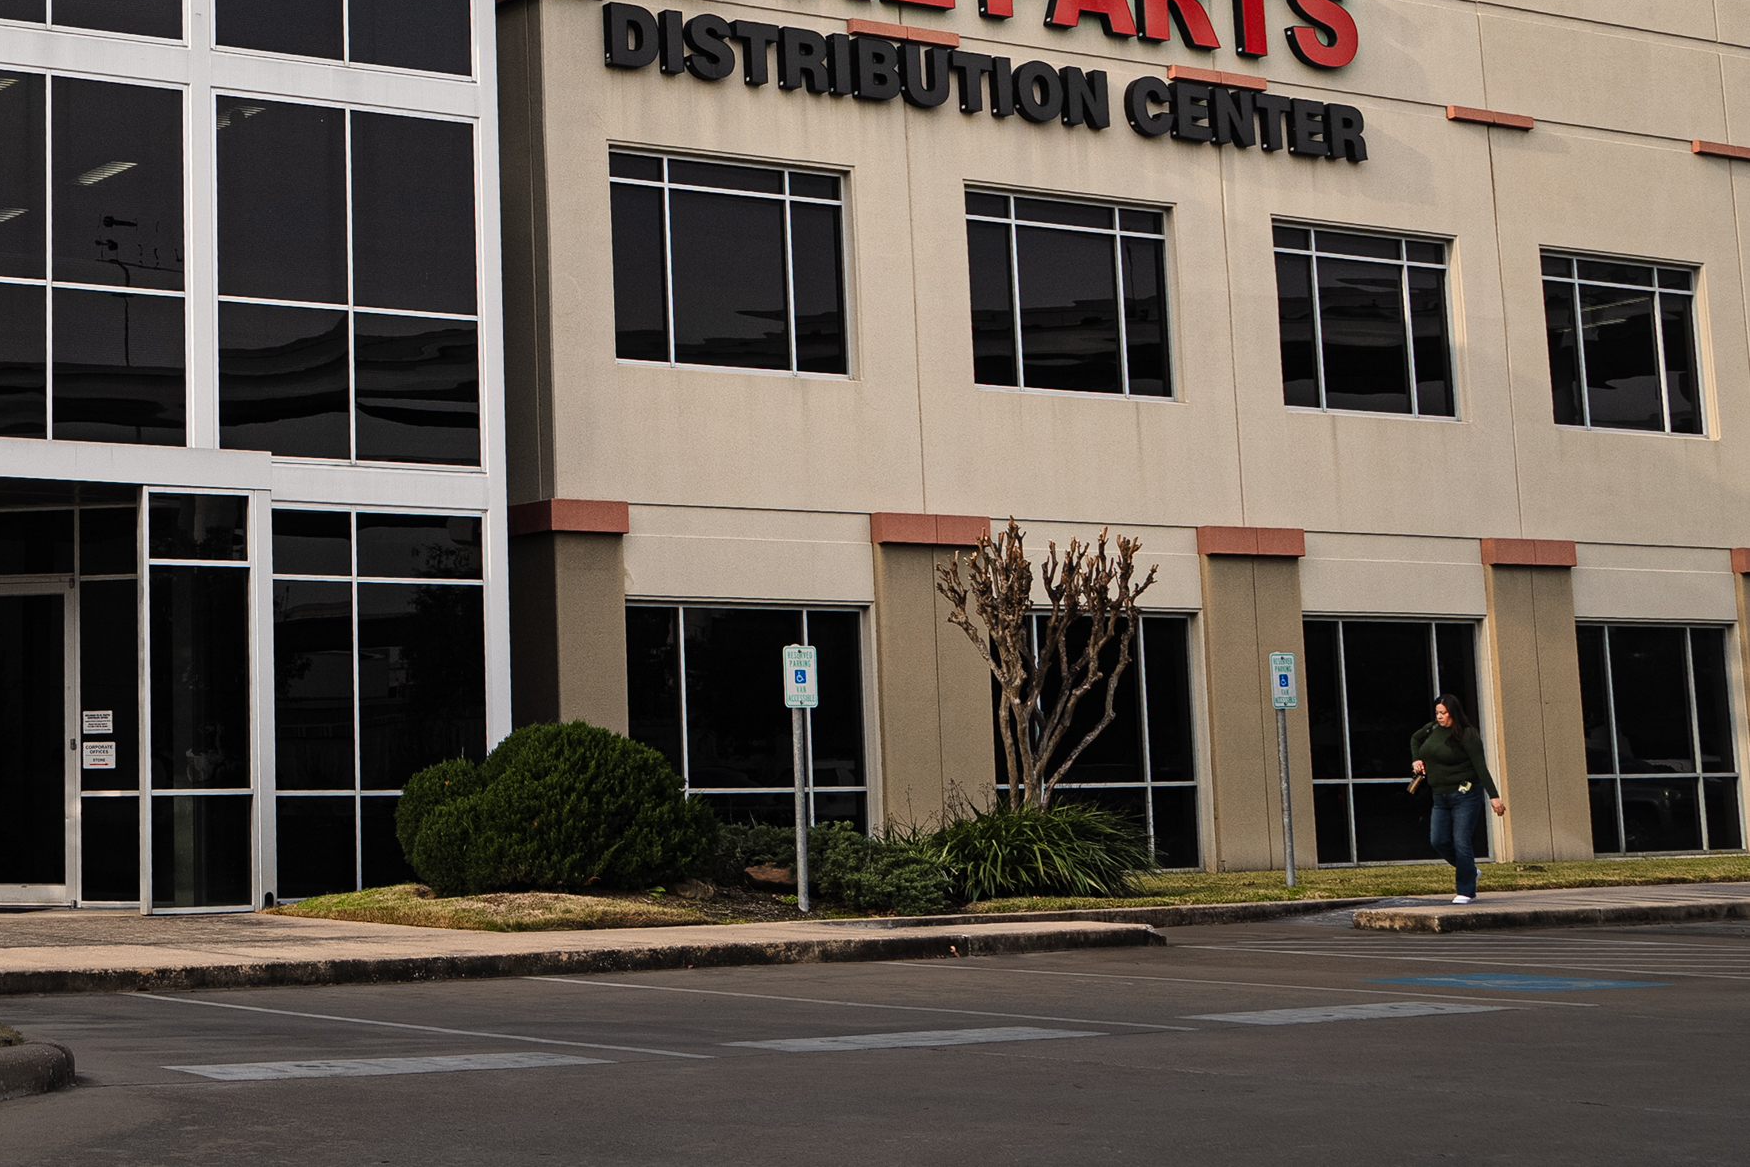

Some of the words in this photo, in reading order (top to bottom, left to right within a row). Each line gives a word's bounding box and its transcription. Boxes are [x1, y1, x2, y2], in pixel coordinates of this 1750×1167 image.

[602, 1, 1111, 131] DISTRIBUTION
[1124, 76, 1368, 163] CENTER
[789, 660, 812, 668] PARKING
